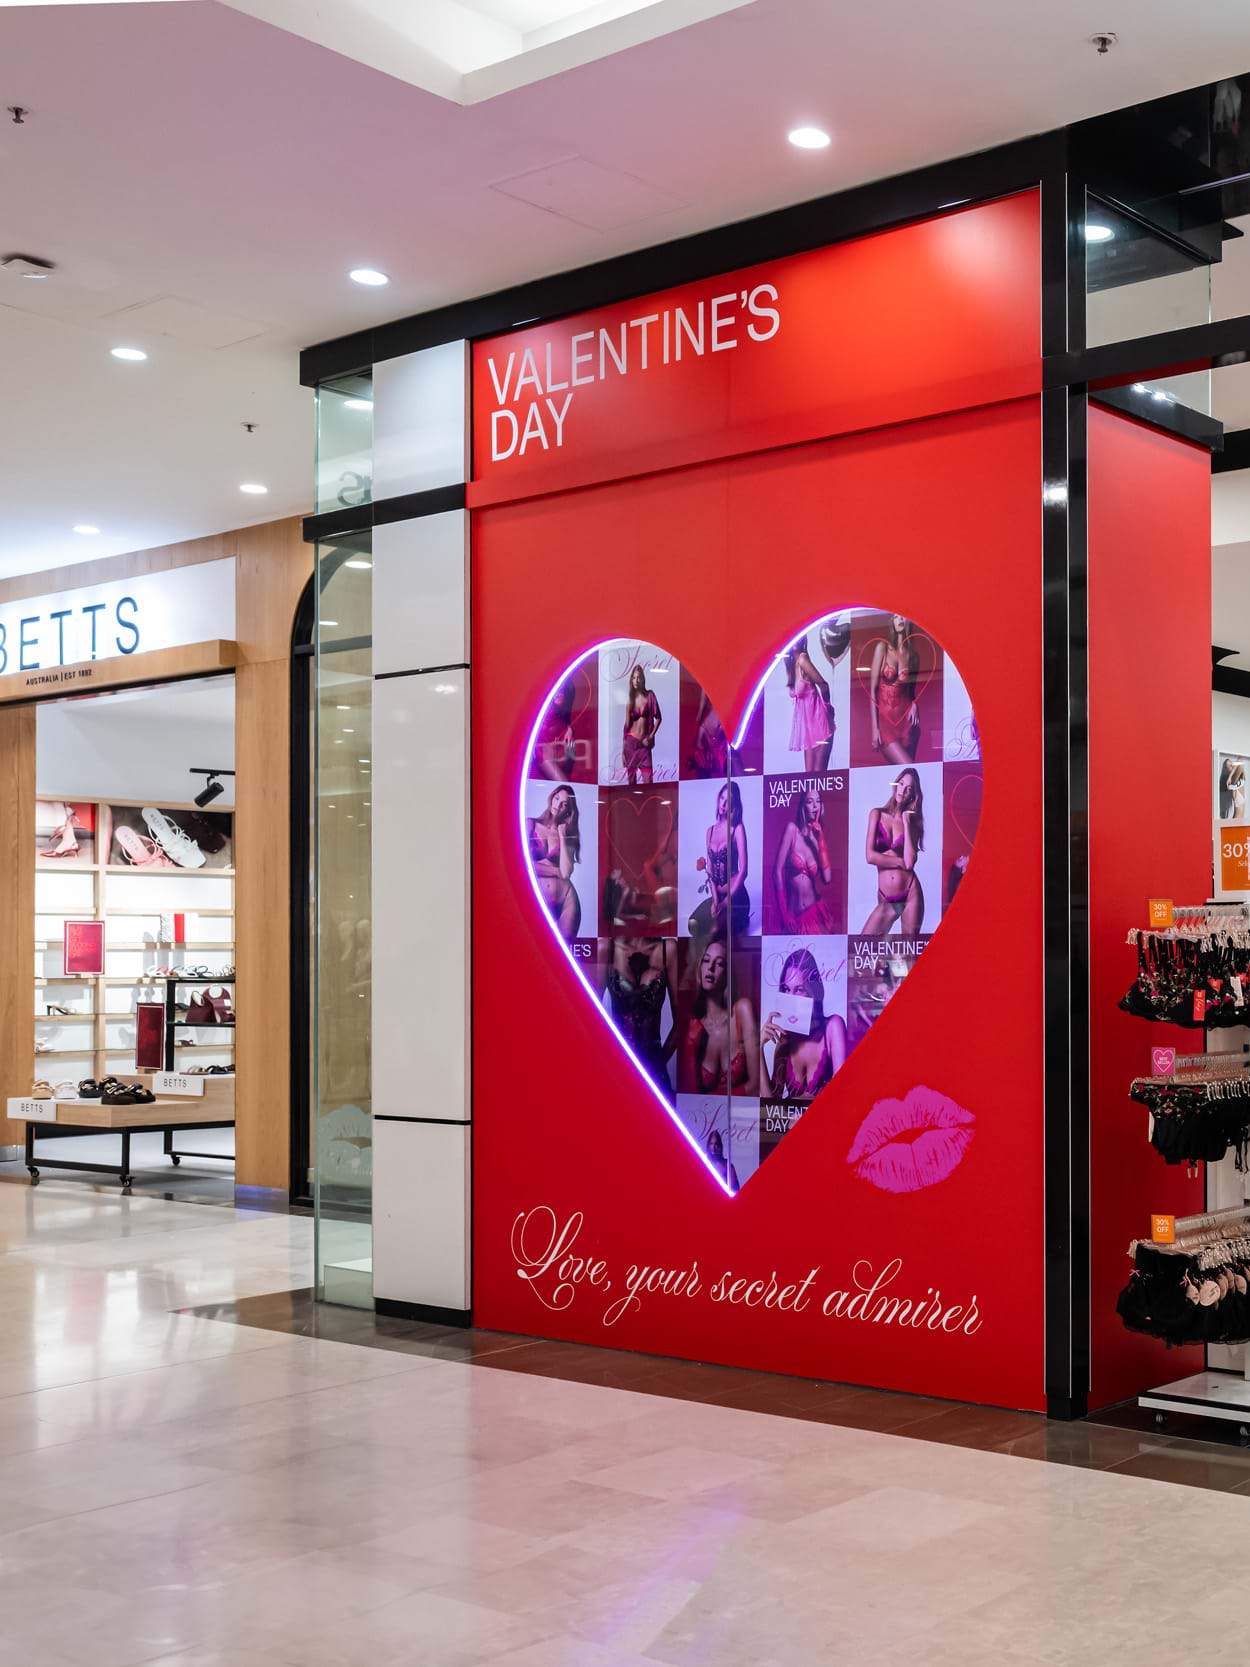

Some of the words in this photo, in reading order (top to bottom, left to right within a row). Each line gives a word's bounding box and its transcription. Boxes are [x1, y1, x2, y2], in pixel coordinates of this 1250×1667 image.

[487, 282, 781, 406] VALENTINE'S
[490, 392, 574, 463] DAY
[25, 674, 59, 686] AUSTRALIA
[769, 776, 844, 795] VALENTINE'S
[769, 794, 793, 809] DAY
[1153, 903, 1168, 911] 30%
[853, 941, 930, 955] VALENTINE'
[854, 955, 879, 970] DAY
[163, 1078, 188, 1089] BETTS
[20, 1102, 44, 1113] BETTS
[765, 1118, 789, 1133] DAY
[510, 1204, 612, 1311] Love,
[602, 1260, 702, 1327] your
[709, 1265, 822, 1314] secret
[822, 1257, 984, 1336] admirer
